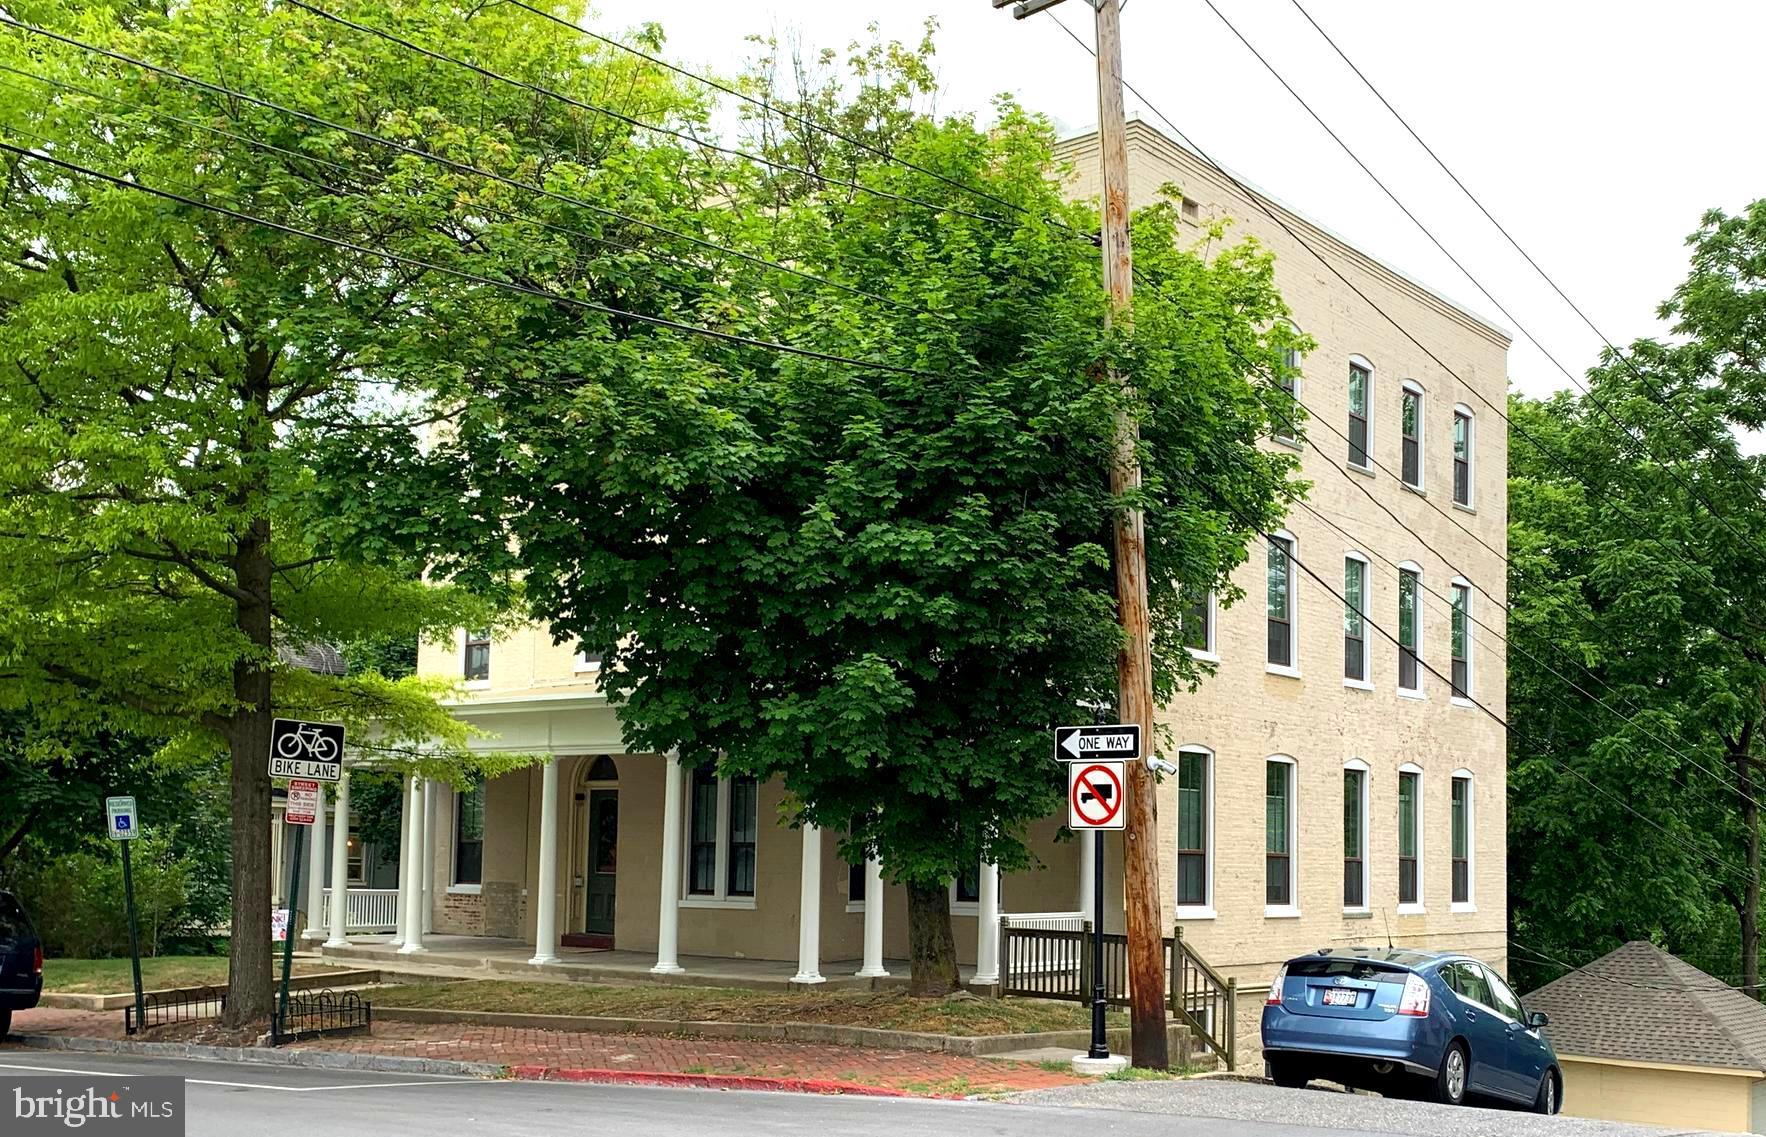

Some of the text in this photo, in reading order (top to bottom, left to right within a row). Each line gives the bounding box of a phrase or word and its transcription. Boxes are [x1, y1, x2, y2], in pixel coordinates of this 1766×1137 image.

[1078, 736, 1130, 750] ONE WAY
[275, 760, 337, 778] BIKE LANE
